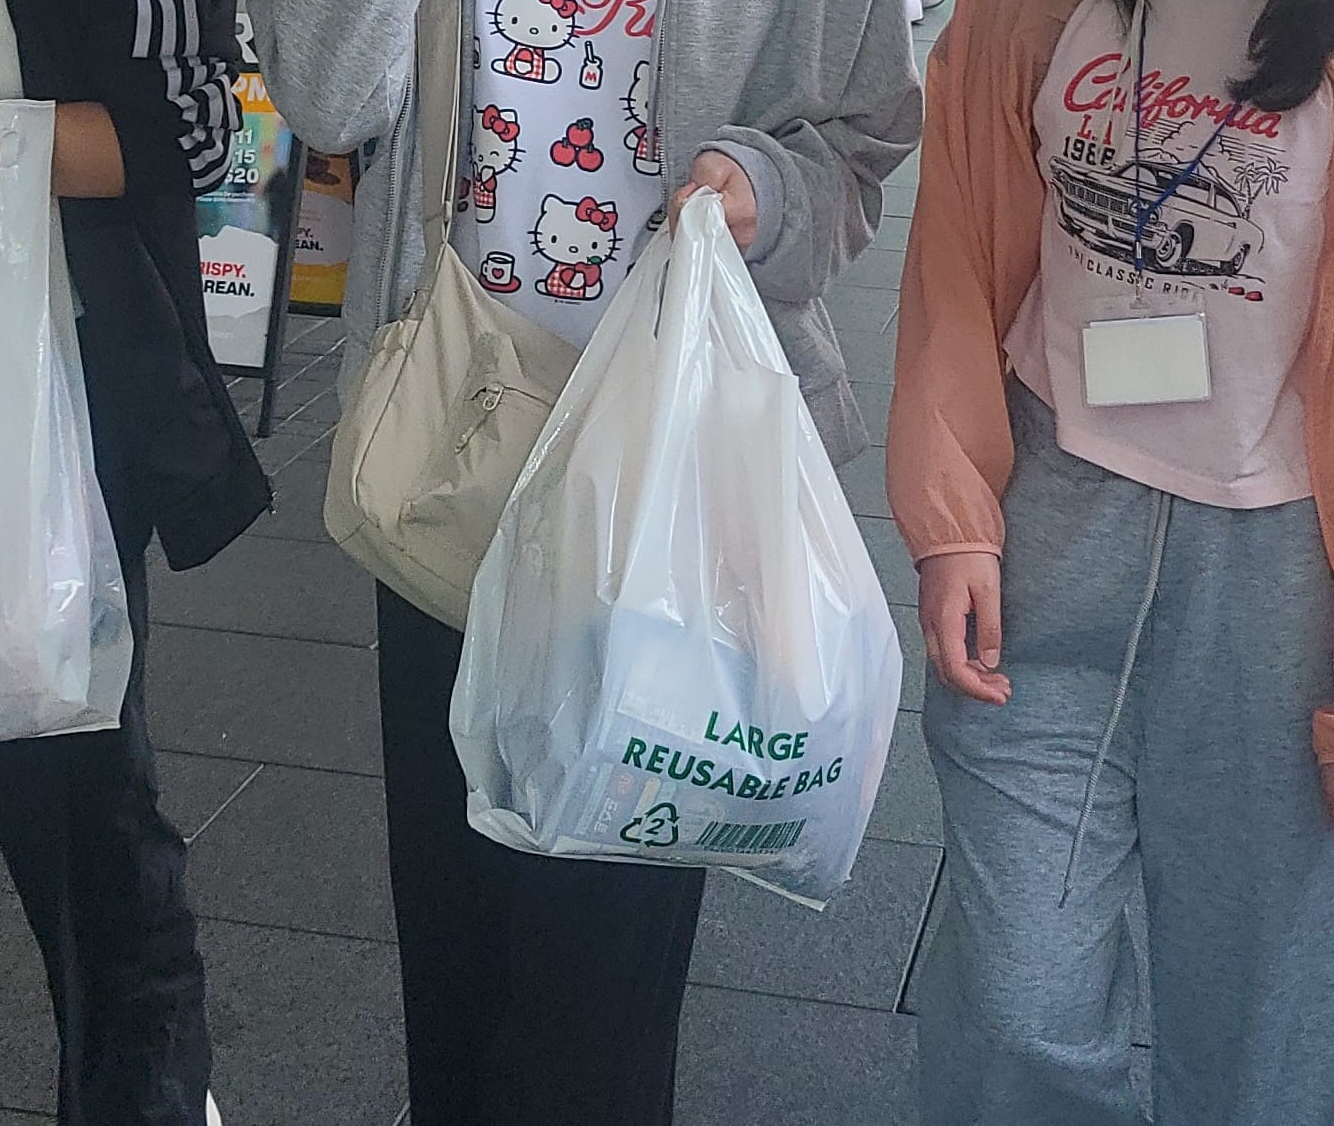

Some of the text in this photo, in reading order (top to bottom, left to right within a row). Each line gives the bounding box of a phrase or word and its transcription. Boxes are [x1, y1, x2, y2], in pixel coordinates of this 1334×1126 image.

[199, 261, 247, 279] RISPY.
[203, 279, 256, 298] REAN.
[703, 710, 810, 762] LARGE
[622, 736, 844, 802] REUSABLE BAG
[644, 817, 666, 836] 2
